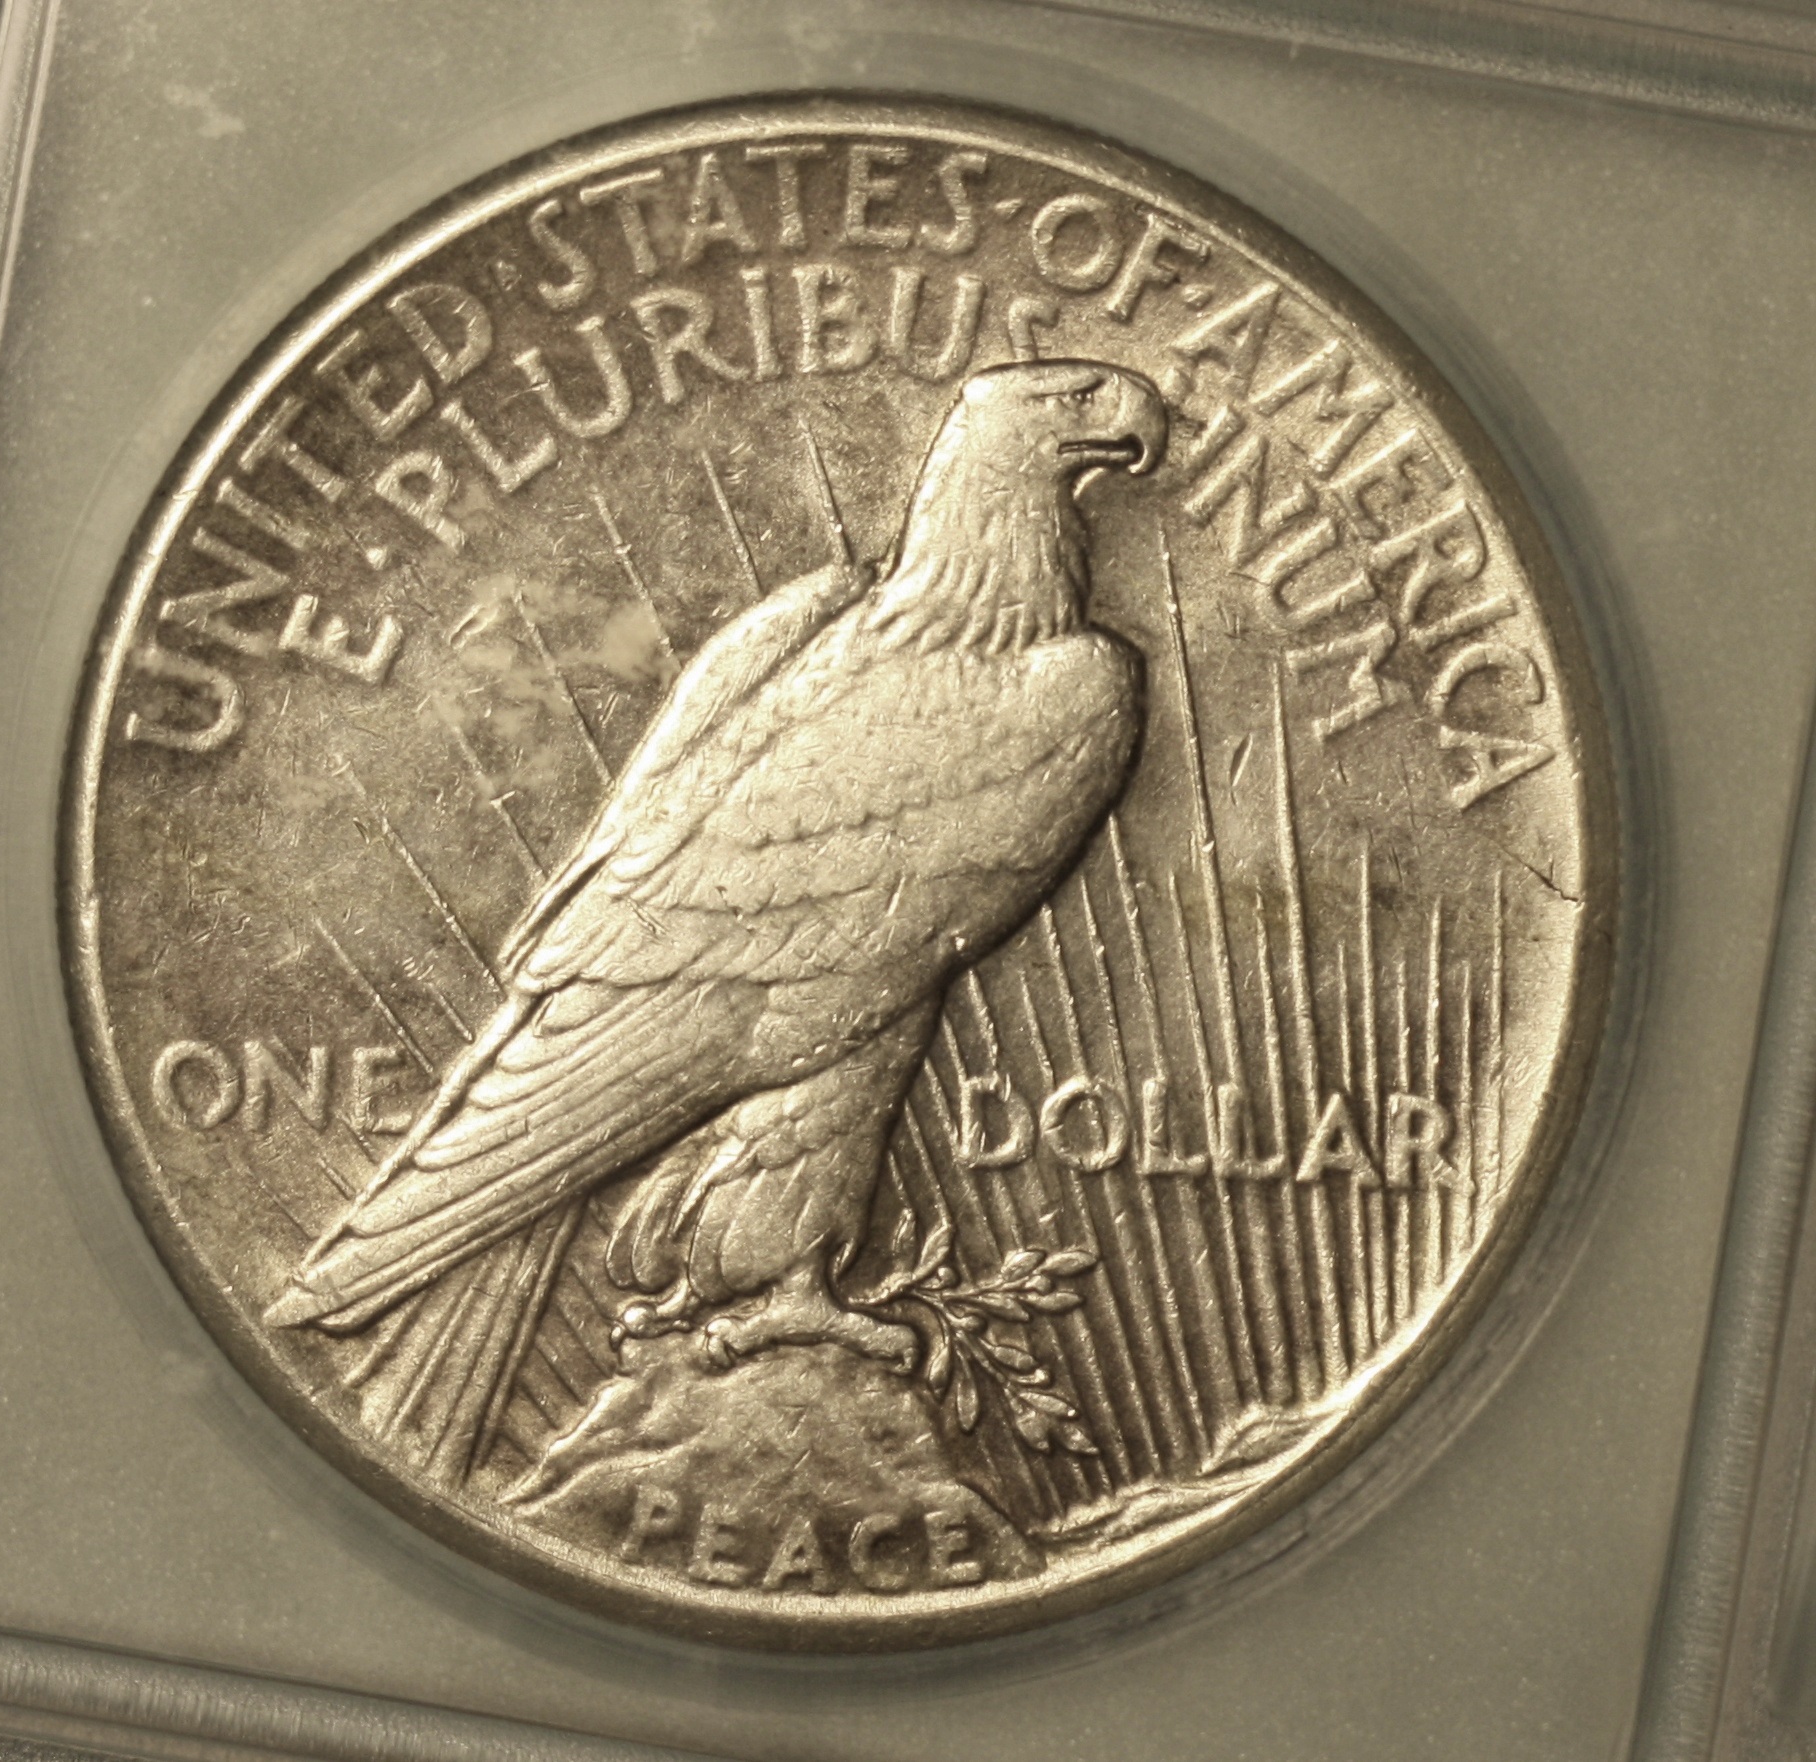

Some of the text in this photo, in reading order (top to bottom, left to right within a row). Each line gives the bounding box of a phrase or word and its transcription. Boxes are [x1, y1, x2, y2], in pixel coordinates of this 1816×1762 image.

[126, 143, 1556, 812] UNITED STATES OF AMERICA
[279, 594, 403, 682] E
[152, 1040, 1477, 1197] ONE DOLLAR
[618, 1482, 982, 1591] PEACE
